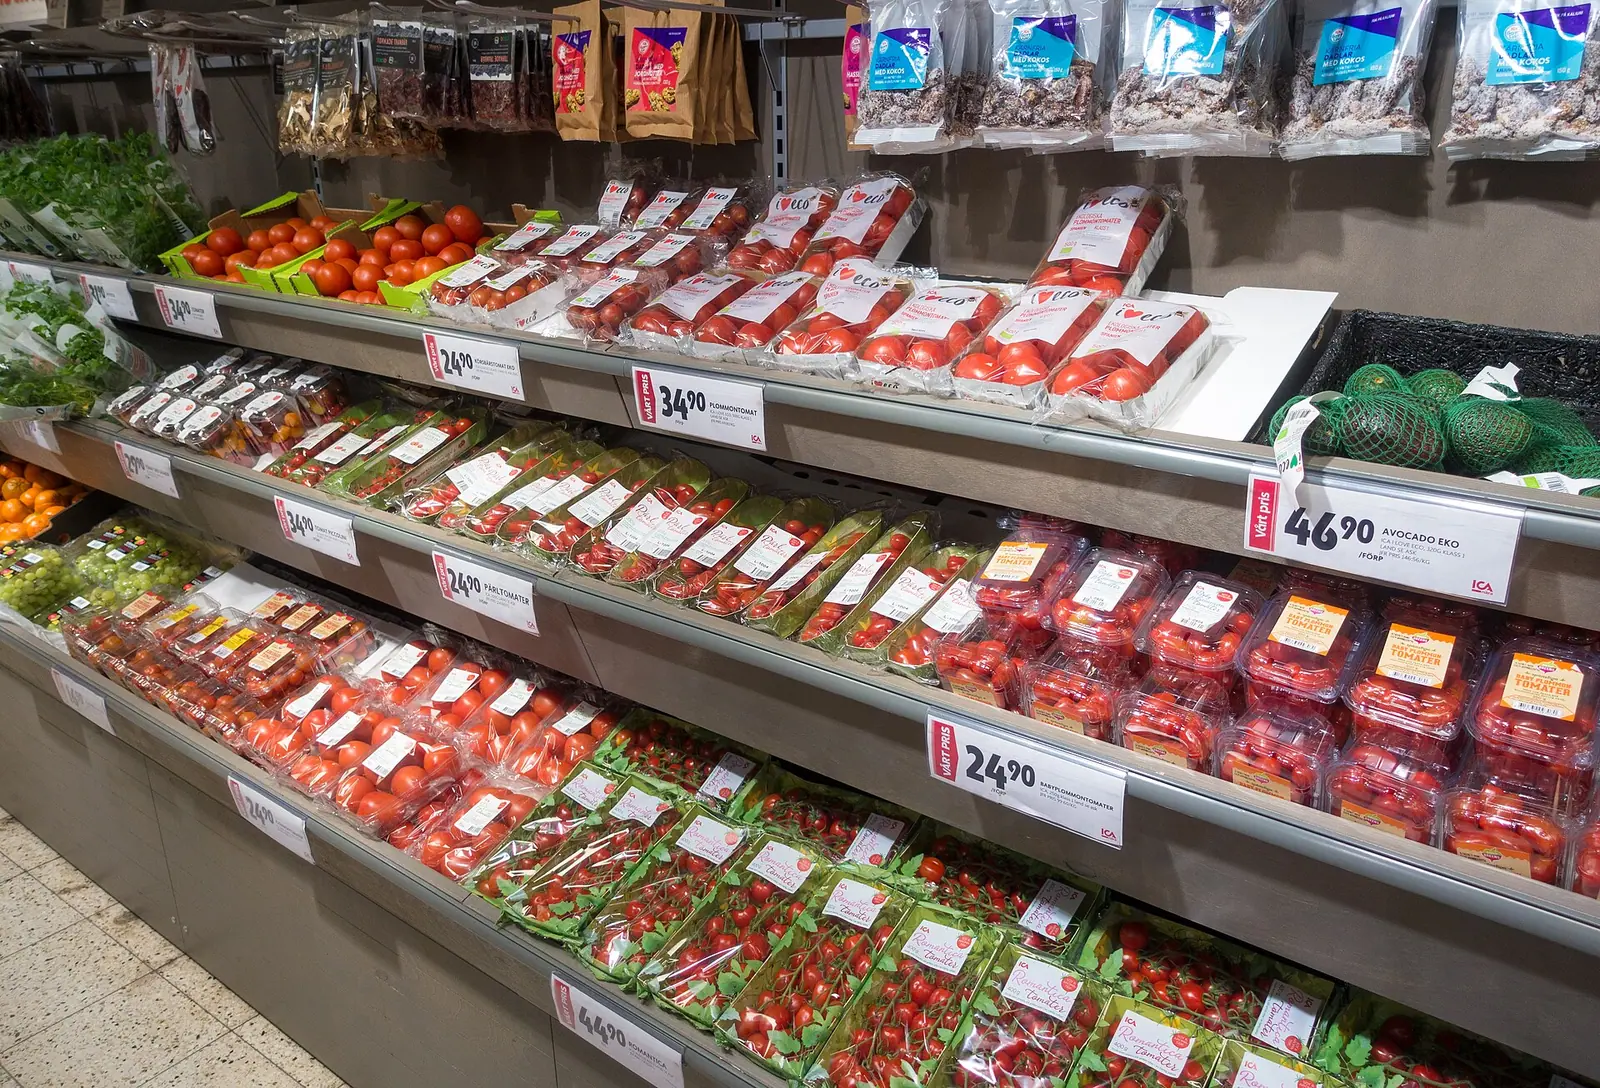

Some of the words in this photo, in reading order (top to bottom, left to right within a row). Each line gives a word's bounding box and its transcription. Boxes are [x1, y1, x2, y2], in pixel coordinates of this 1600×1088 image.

[1322, 59, 1338, 68] MED
[1340, 56, 1366, 66] KOKOS
[1520, 57, 1550, 66] KOKOS
[791, 198, 810, 210] eco
[863, 194, 885, 205] eco
[1102, 196, 1128, 209] eco
[853, 273, 880, 290] eco
[938, 295, 966, 306] eco
[1052, 288, 1080, 302] eco
[642, 374, 650, 394] PRIS
[644, 396, 654, 420] VÅRT
[709, 402, 758, 416] PLOMMONTOMAT
[1260, 491, 1271, 514] pris
[1254, 515, 1268, 538] Vårt
[1382, 528, 1436, 544] AVOCADO
[1438, 537, 1460, 549] EKO
[996, 558, 1032, 566] TOMATER
[1358, 551, 1384, 562] /FÖRP
[1442, 550, 1461, 558] KLASS
[1472, 579, 1494, 592] ICA
[484, 583, 530, 606] PÄRLTOMATER
[1286, 618, 1332, 636] TOMATER
[1390, 648, 1440, 666] TOMATER
[1514, 678, 1571, 696] TOMATER
[942, 726, 950, 751] PRIS
[943, 752, 952, 776] VÅRT
[1040, 781, 1114, 811] BABYPLOMMONTOMATER
[1101, 828, 1116, 838] ICA
[920, 925, 930, 934] ICA
[924, 950, 959, 970] tomater
[1018, 961, 1030, 970] ICA
[1012, 970, 1073, 1004] Romantica
[1024, 987, 1067, 1015] tomater
[1304, 998, 1314, 1008] ICA
[1124, 1016, 1137, 1028] ICA
[1260, 1000, 1284, 1038] tomater
[1118, 1025, 1184, 1062] Romantica
[628, 1041, 668, 1070] ROMANTICA
[1133, 1045, 1180, 1073] tomater
[1244, 1060, 1258, 1071] ICA
